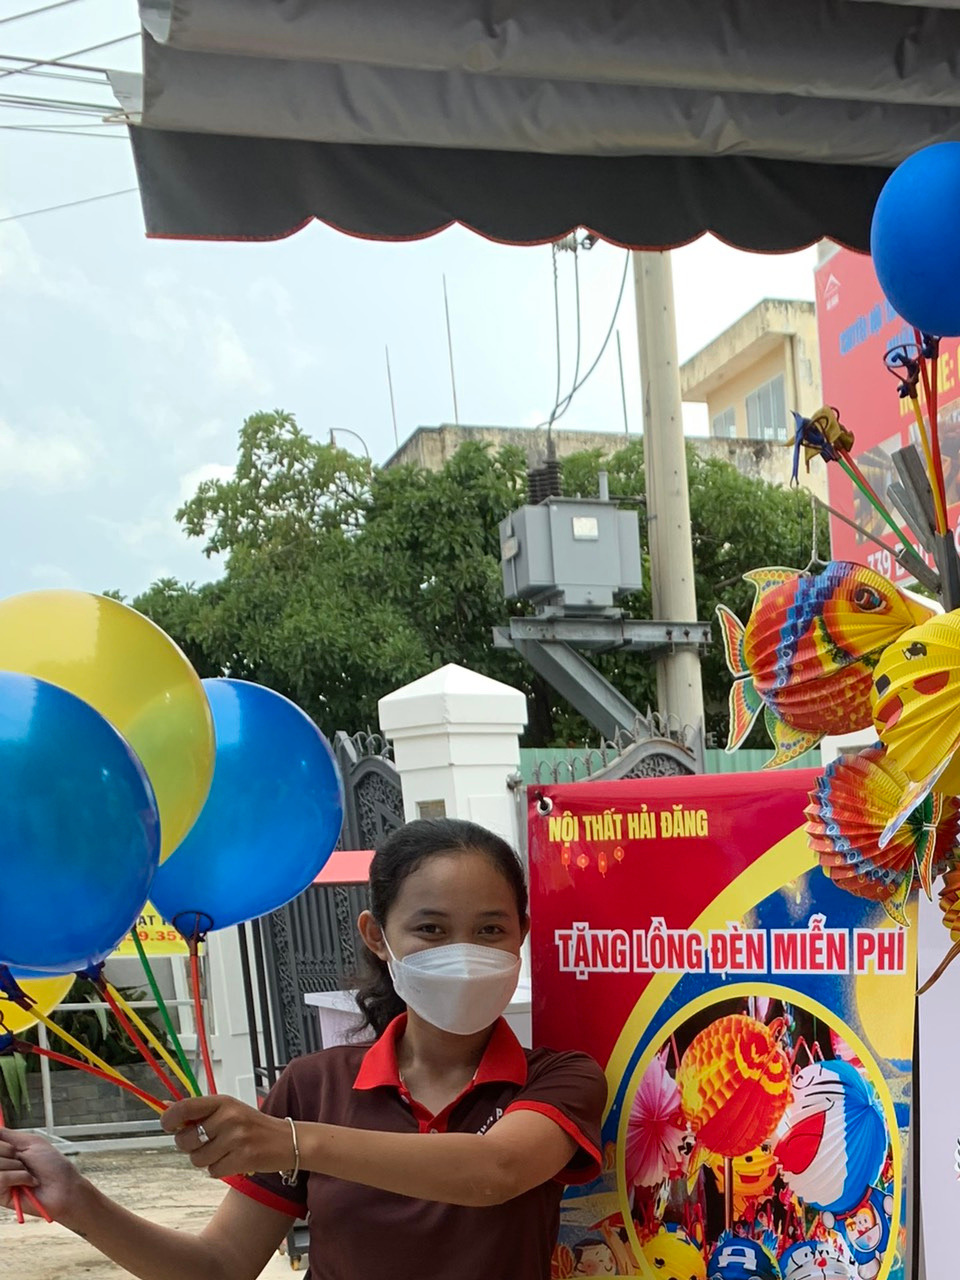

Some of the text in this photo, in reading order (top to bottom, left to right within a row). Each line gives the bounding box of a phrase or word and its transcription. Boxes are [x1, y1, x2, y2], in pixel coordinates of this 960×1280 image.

[548, 803, 709, 847] NỘI THẤT HẢI ĐĂNG
[557, 916, 906, 978] TẶNG LỒNG ĐÈN MIỄN PHÍ
